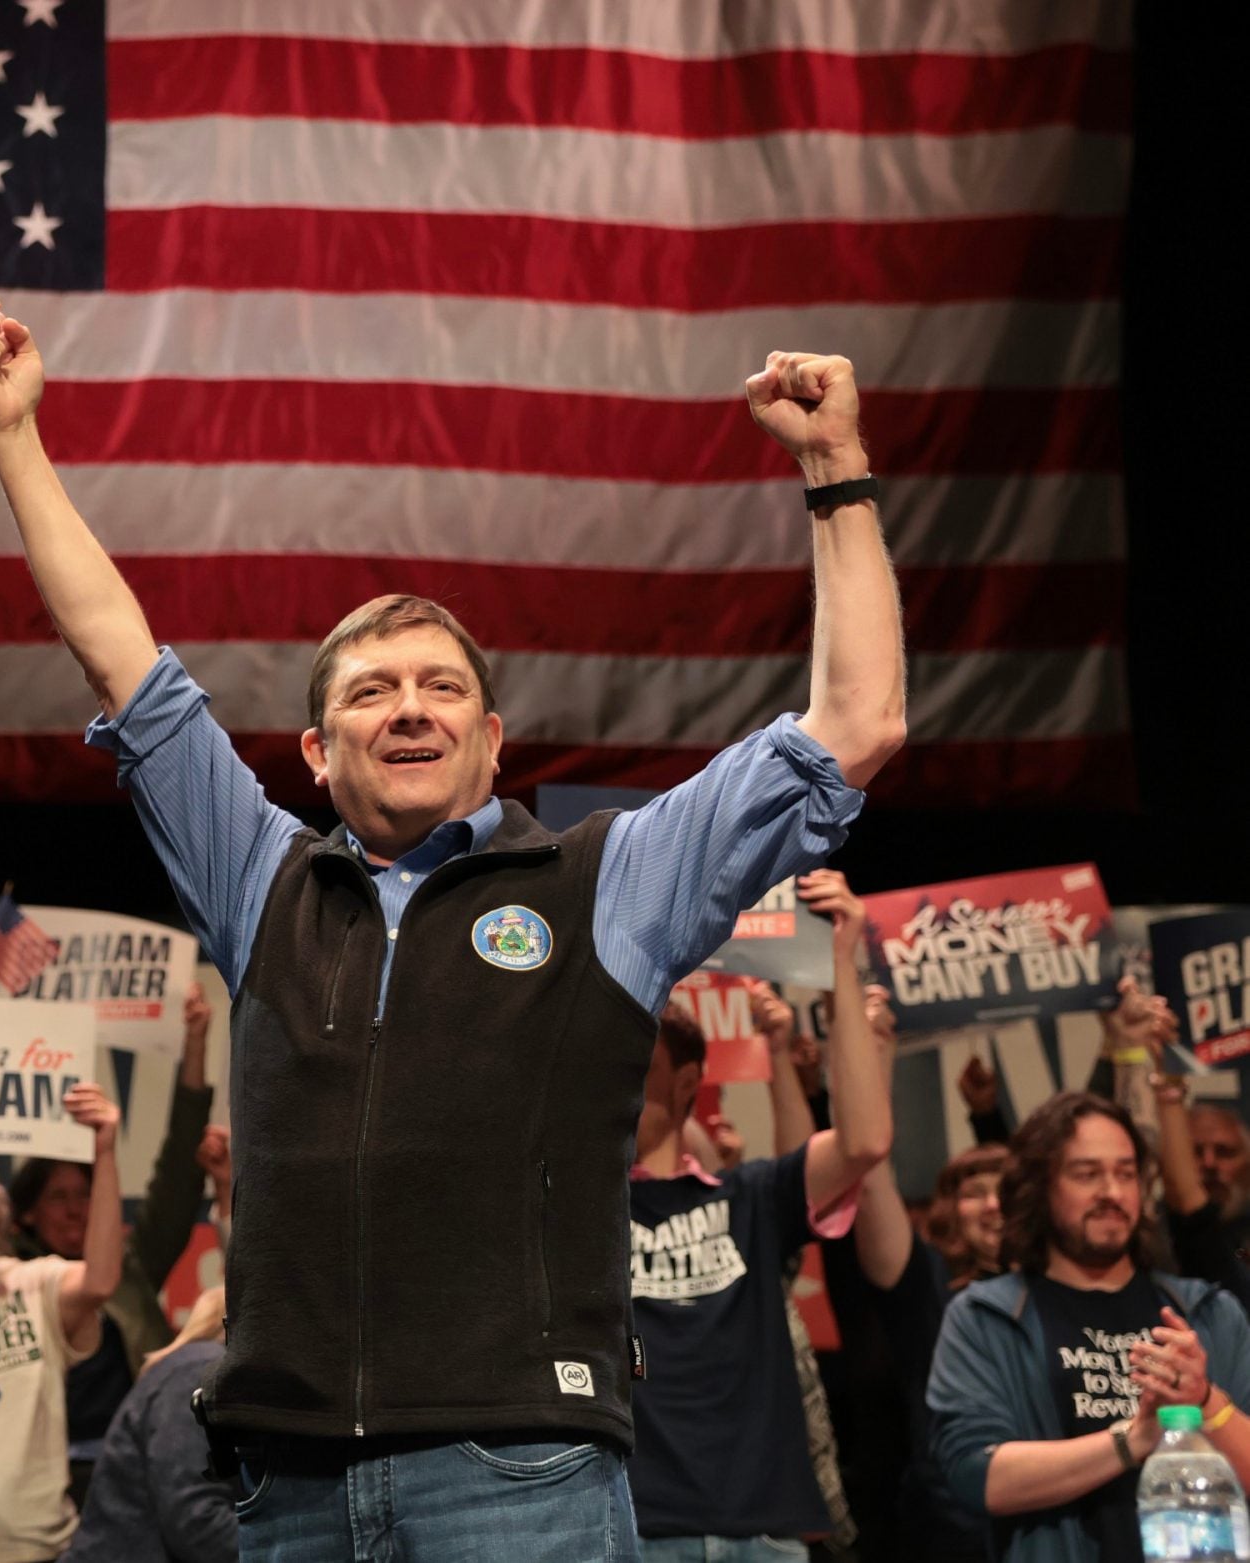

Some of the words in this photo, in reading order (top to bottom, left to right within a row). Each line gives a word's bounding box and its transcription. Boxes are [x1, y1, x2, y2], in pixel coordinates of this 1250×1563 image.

[882, 913, 1092, 968] MONEY
[892, 951, 1012, 1007] CAN'T
[1020, 940, 1101, 993] BUY
[18, 1036, 75, 1071] for
[630, 1199, 730, 1254] RAHAM
[630, 1233, 740, 1280] LATNER
